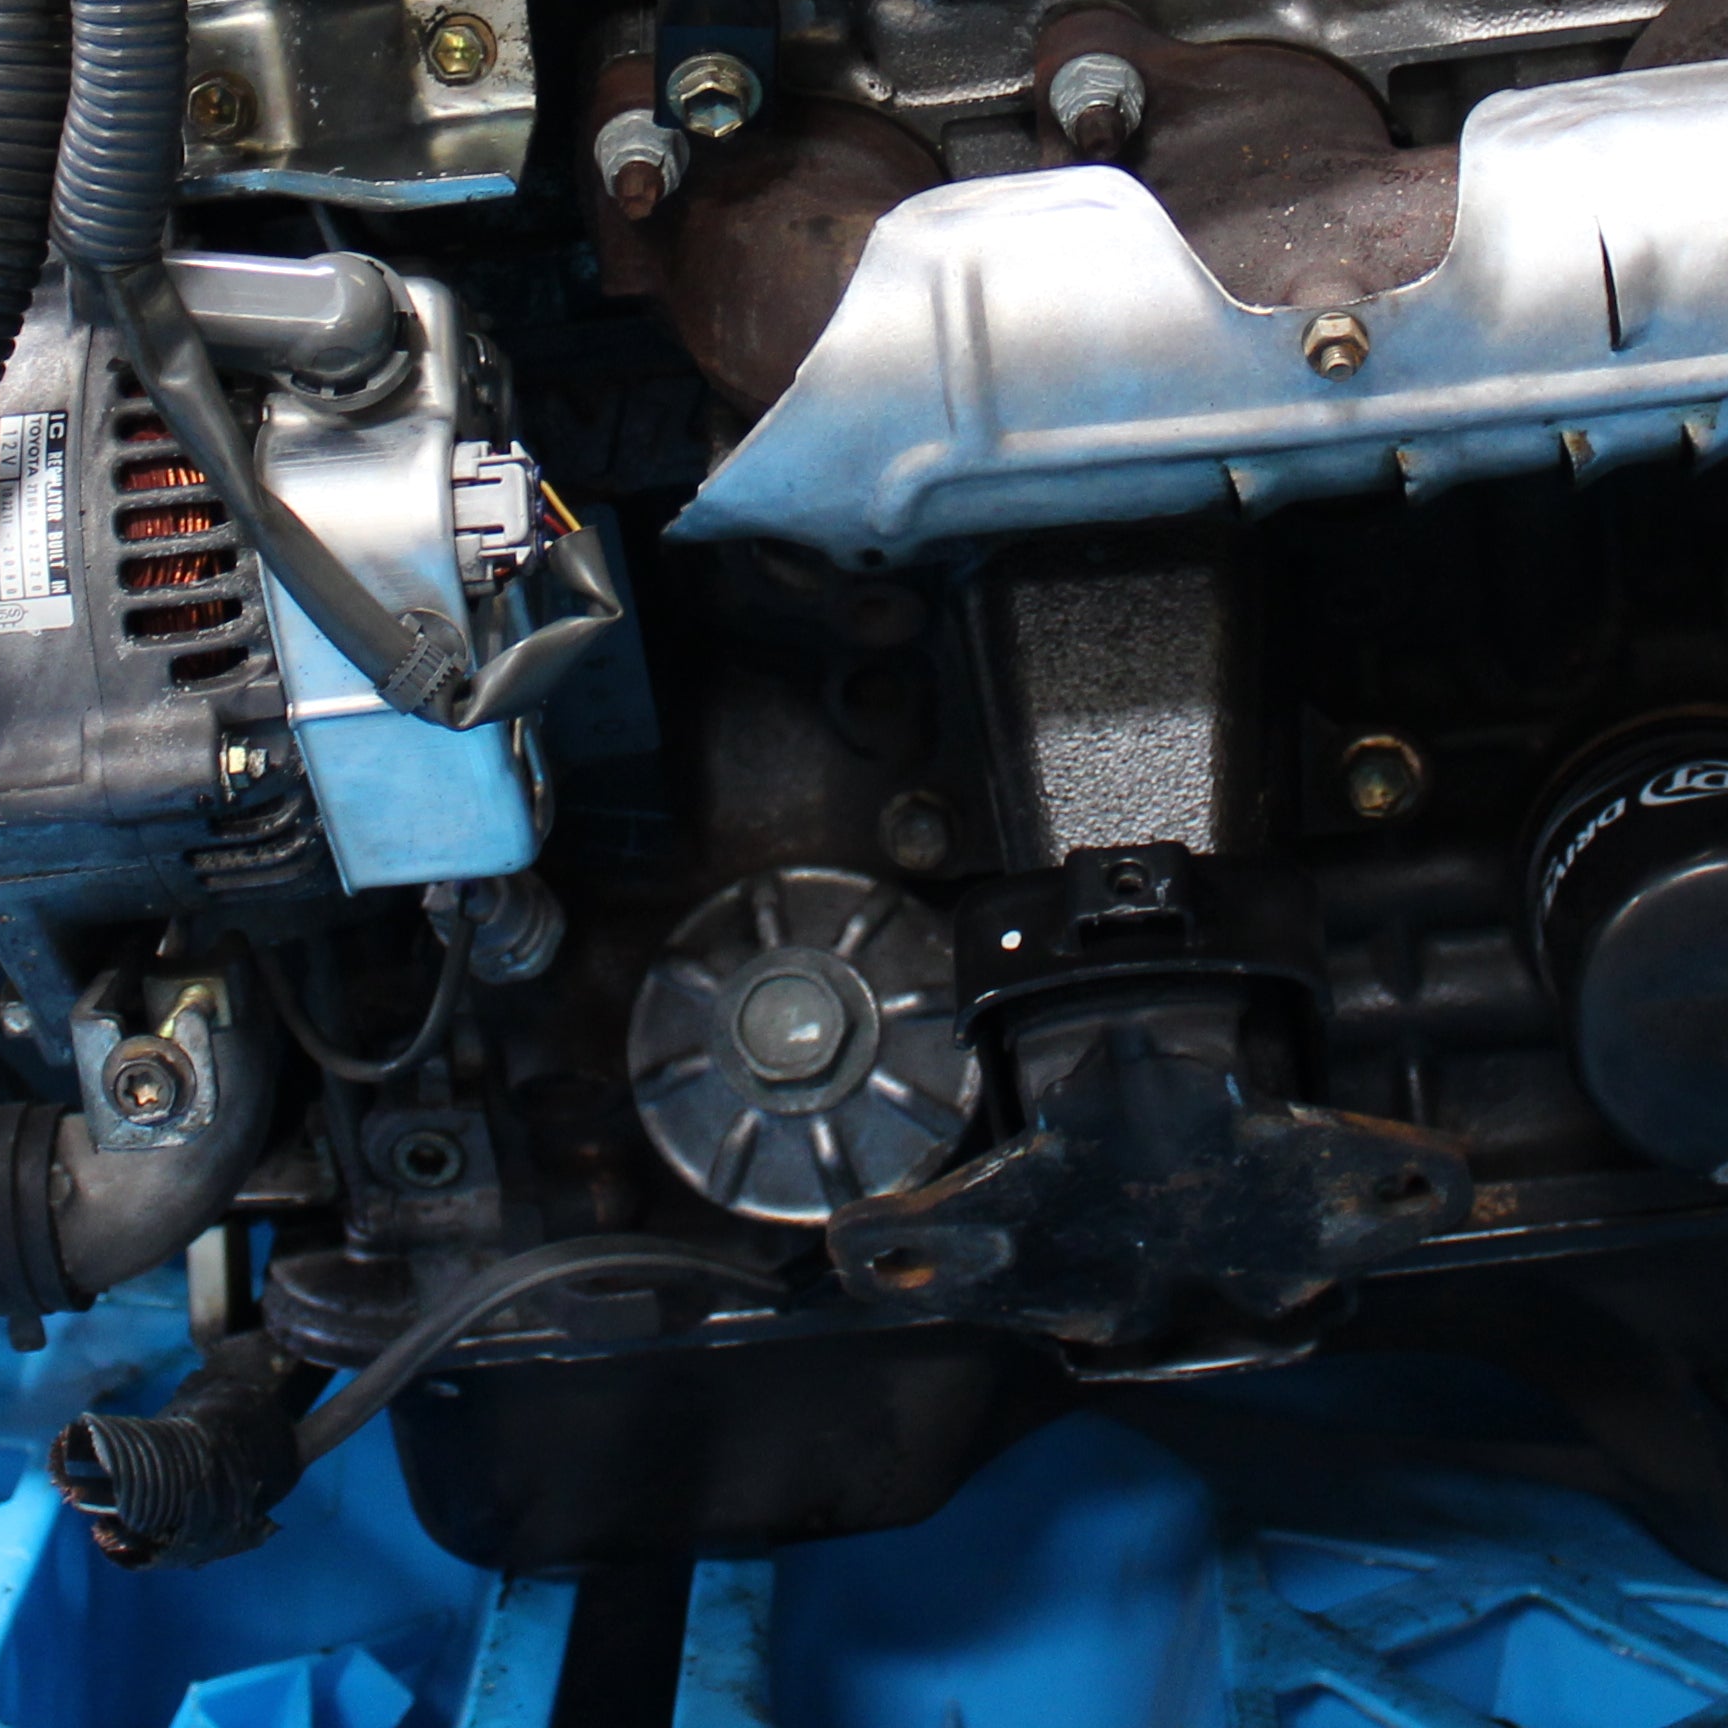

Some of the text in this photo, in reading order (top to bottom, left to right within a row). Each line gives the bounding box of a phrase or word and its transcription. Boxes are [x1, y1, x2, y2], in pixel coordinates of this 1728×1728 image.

[48, 413, 66, 439] IC
[27, 417, 42, 477] TOYOTA
[48, 530, 65, 570] BUILT
[49, 580, 66, 595] IN
